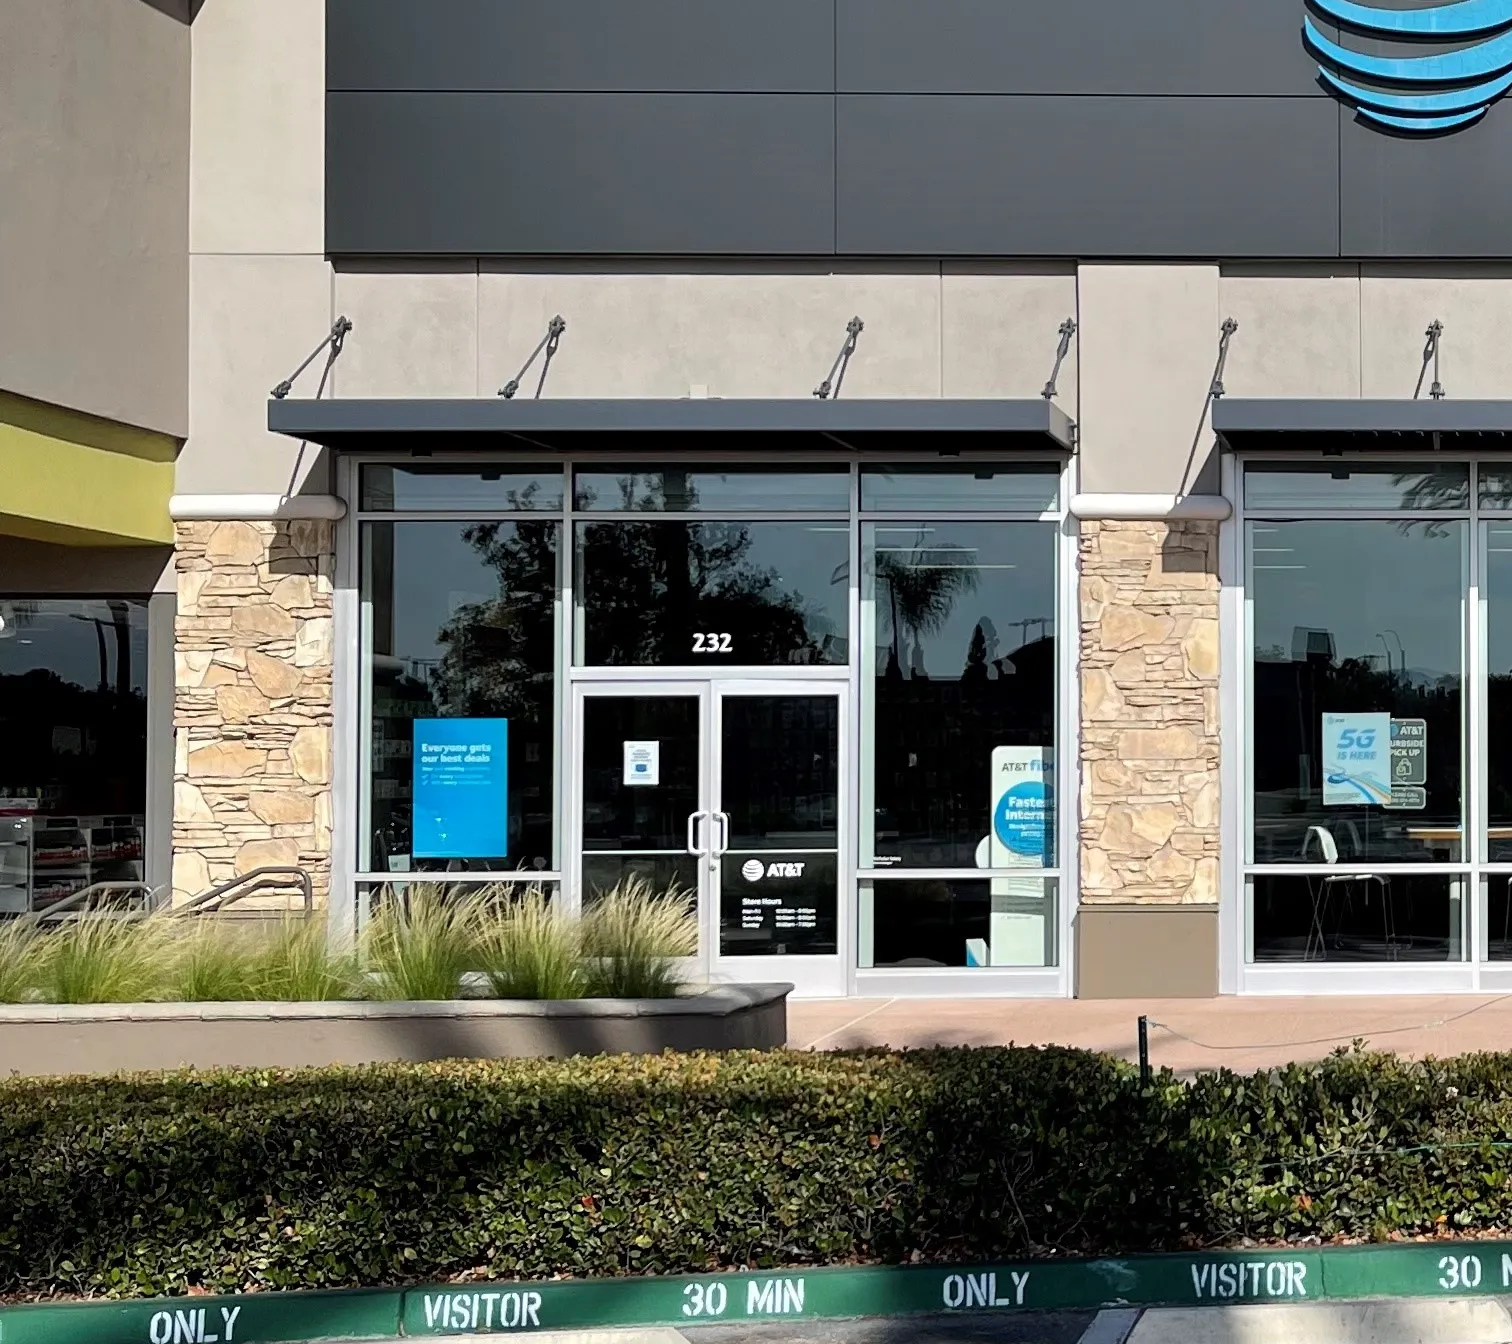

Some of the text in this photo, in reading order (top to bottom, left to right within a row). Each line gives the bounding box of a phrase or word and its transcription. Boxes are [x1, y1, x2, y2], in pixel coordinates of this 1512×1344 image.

[691, 632, 733, 653] 232
[1400, 726, 1424, 735] AT&T
[1337, 728, 1377, 749] 5G
[1390, 739, 1424, 747] URBSIDE
[421, 743, 492, 754] Everyone gets
[1409, 749, 1421, 757] UP
[440, 754, 463, 763] best
[464, 754, 491, 763] deals
[1338, 751, 1377, 761] IS HERE
[1001, 762, 1028, 772] AT&T
[766, 862, 805, 877] AT&T
[1191, 1260, 1308, 1298] VISITOR
[1437, 1255, 1482, 1289] 30
[423, 1271, 1030, 1329] VISITOR 30 MIN ONLY
[149, 1305, 242, 1344] ONLY
